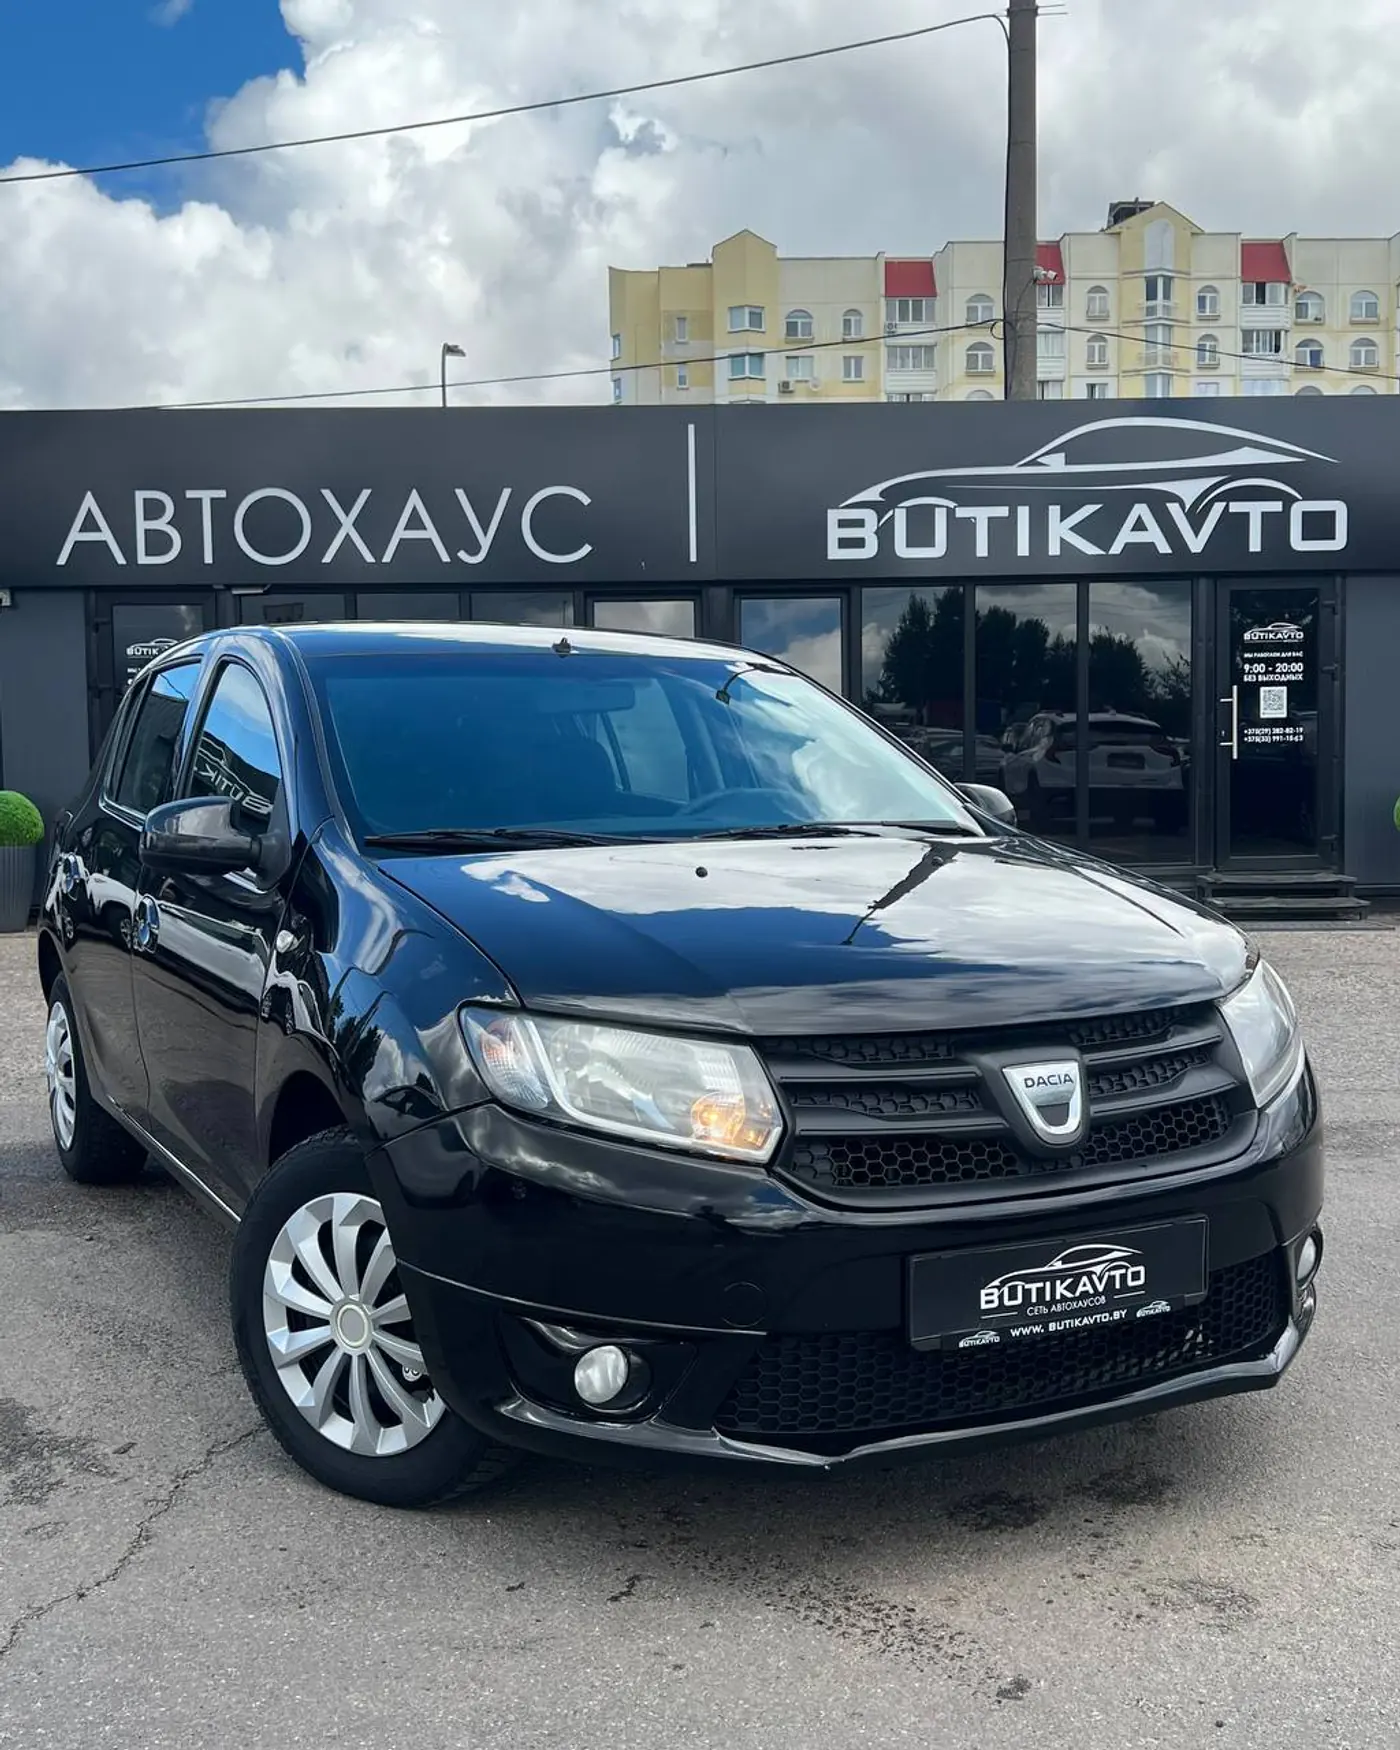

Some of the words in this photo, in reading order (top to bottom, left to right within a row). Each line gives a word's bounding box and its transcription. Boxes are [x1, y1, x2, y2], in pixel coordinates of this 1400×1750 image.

[56, 485, 594, 566] АВТОХАУС
[826, 498, 1349, 561] BUTIKAVTO
[1243, 631, 1304, 640] BUTIKAVTO
[126, 647, 160, 656] BUTIK
[1243, 663, 1266, 674] 9:00
[1275, 662, 1303, 673] 20:00
[1257, 673, 1303, 681] ВЫХОДНЫХ
[1024, 1073, 1074, 1088] DACIA
[980, 1265, 1146, 1310] BUTIKAVTO
[1026, 1304, 1049, 1317] СЕТЬ
[1050, 1295, 1107, 1314] АВТОХАУСОВ
[1010, 1324, 1045, 1337] WWW.
[1048, 1308, 1128, 1332] BUTIKAVTO.BY
[958, 1336, 1001, 1348] BUTIKAVTO
